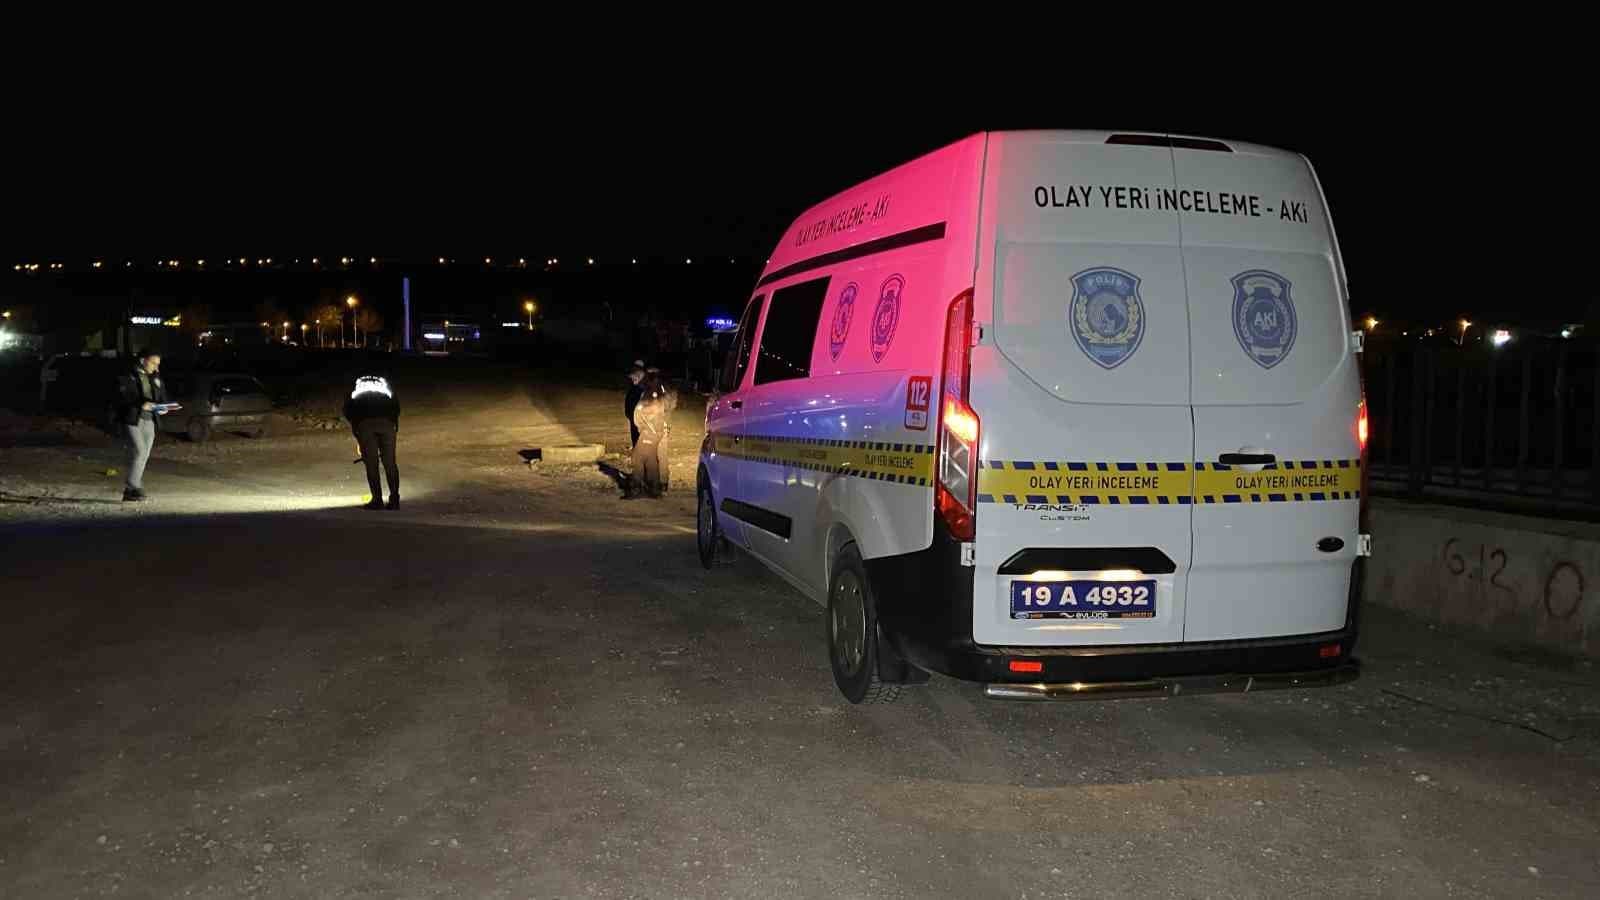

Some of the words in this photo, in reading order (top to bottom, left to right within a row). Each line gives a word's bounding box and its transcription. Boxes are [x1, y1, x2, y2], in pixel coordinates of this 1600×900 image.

[1034, 186, 1092, 208] OLAY
[911, 380, 927, 406] 112
[1030, 476, 1062, 489] OLAY
[1236, 477, 1263, 489] OLAY
[1021, 586, 1052, 606] 19
[1059, 586, 1078, 606] A
[1085, 586, 1149, 606] 4932
